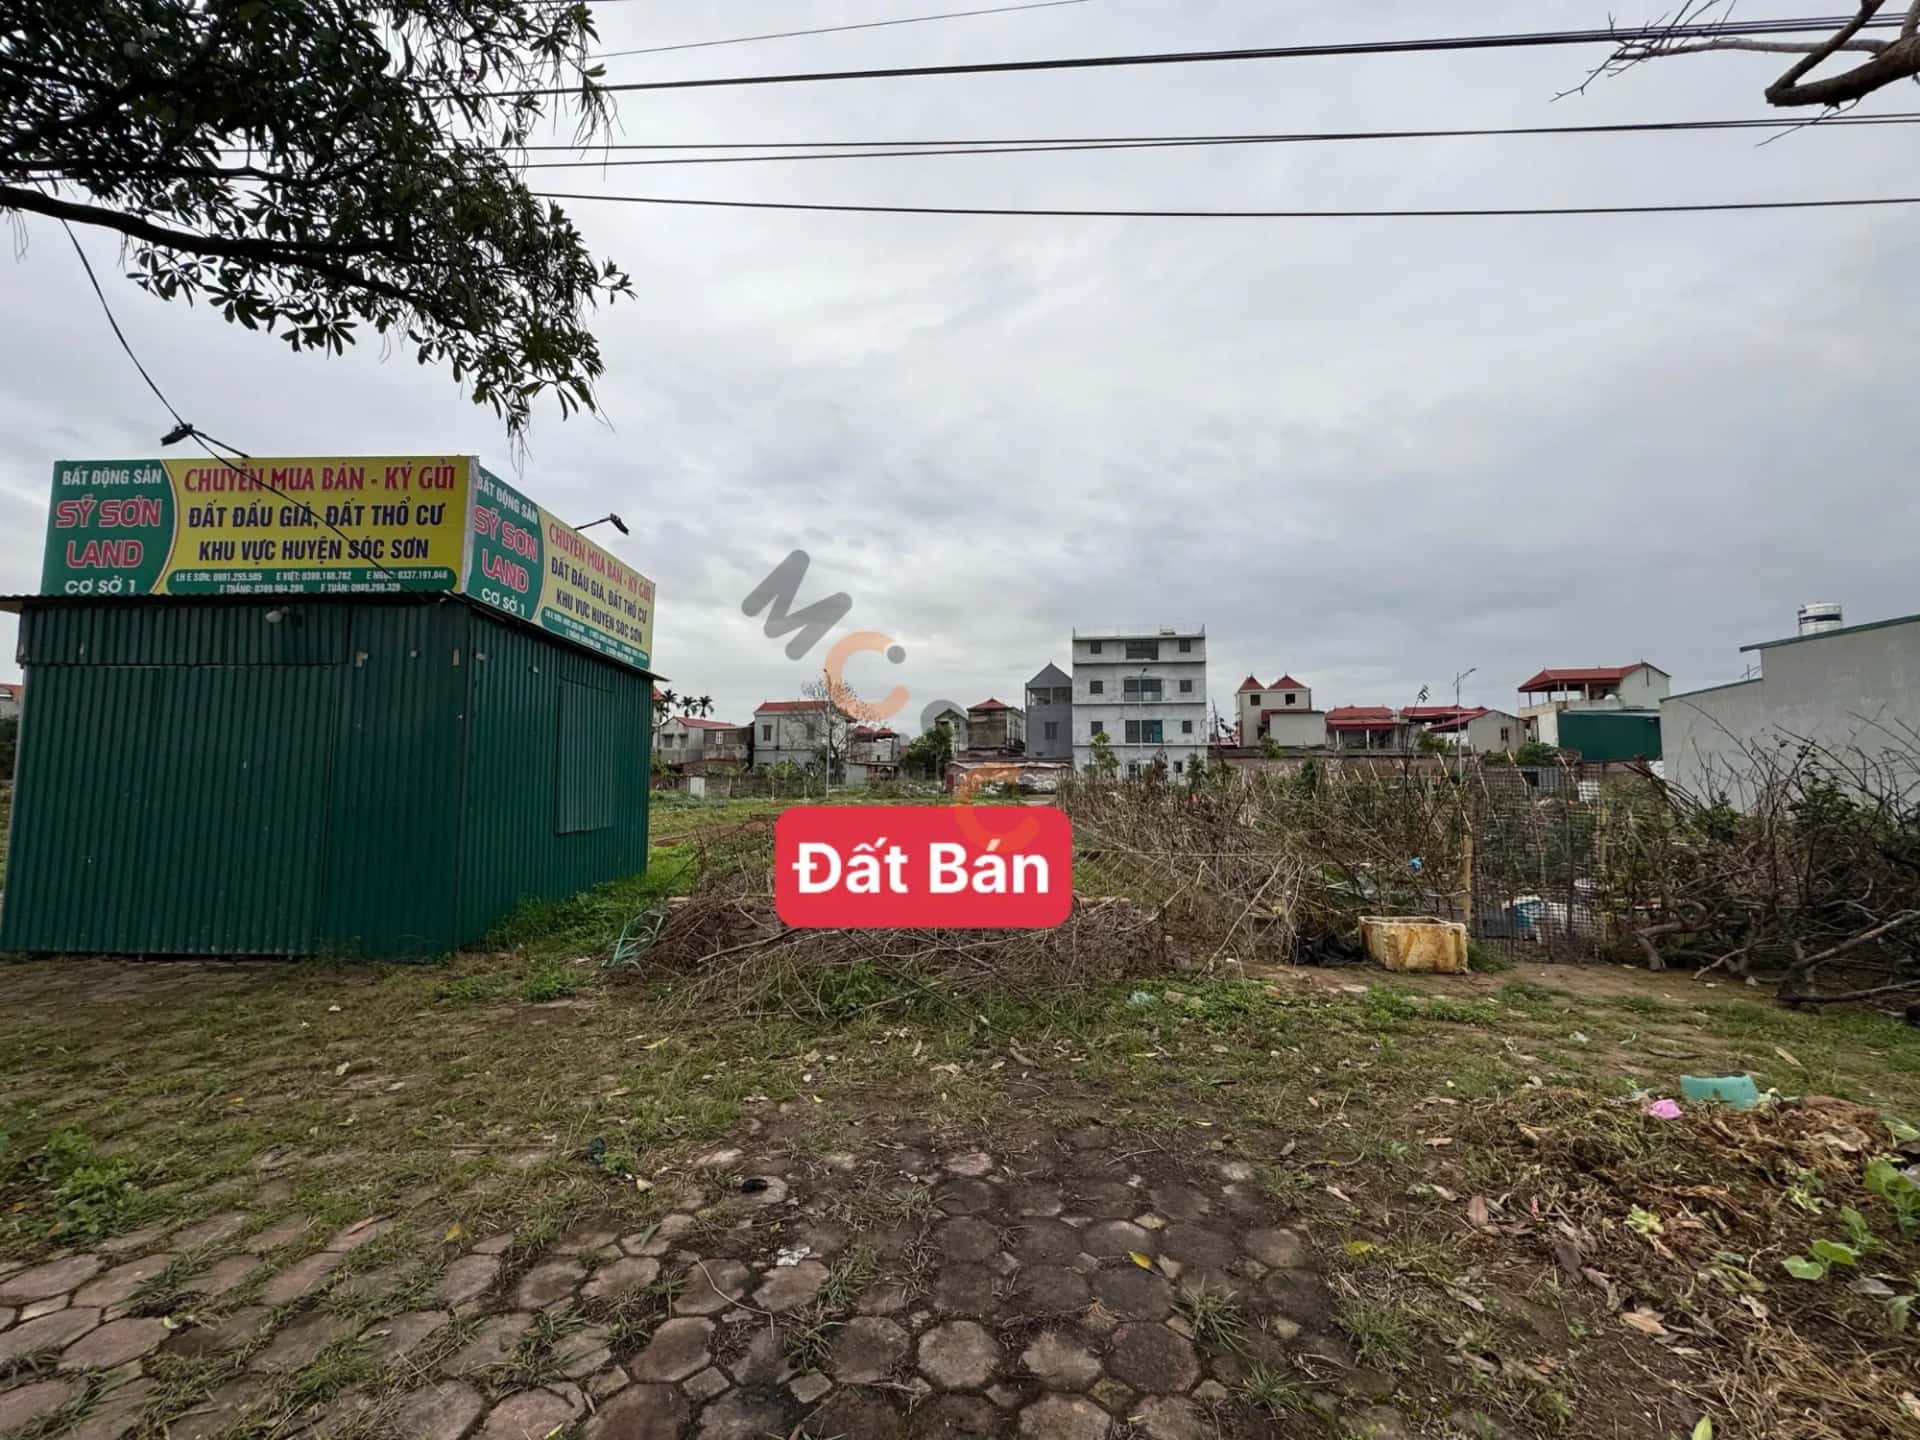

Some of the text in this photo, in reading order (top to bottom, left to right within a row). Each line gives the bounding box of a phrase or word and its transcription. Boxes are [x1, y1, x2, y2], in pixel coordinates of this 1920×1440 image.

[62, 464, 162, 488] BẤT ĐỘNG SẢN
[184, 461, 264, 491] CHUYÊN
[271, 467, 314, 490] MUA
[321, 462, 364, 490] BÁN
[384, 461, 412, 489] KÝ
[98, 495, 163, 527] SƠN
[189, 496, 446, 529] ĐẤT ĐẤU GIÁ, ĐẤT THỔ CƯ
[67, 540, 144, 568] LAND
[199, 536, 429, 565] KHU VỰC HUYỆN SÓC SƠN
[502, 521, 538, 563] SƠN
[65, 575, 136, 594] CƠ SỞ 1
[482, 549, 528, 593] LAND
[556, 588, 574, 611] KHU
